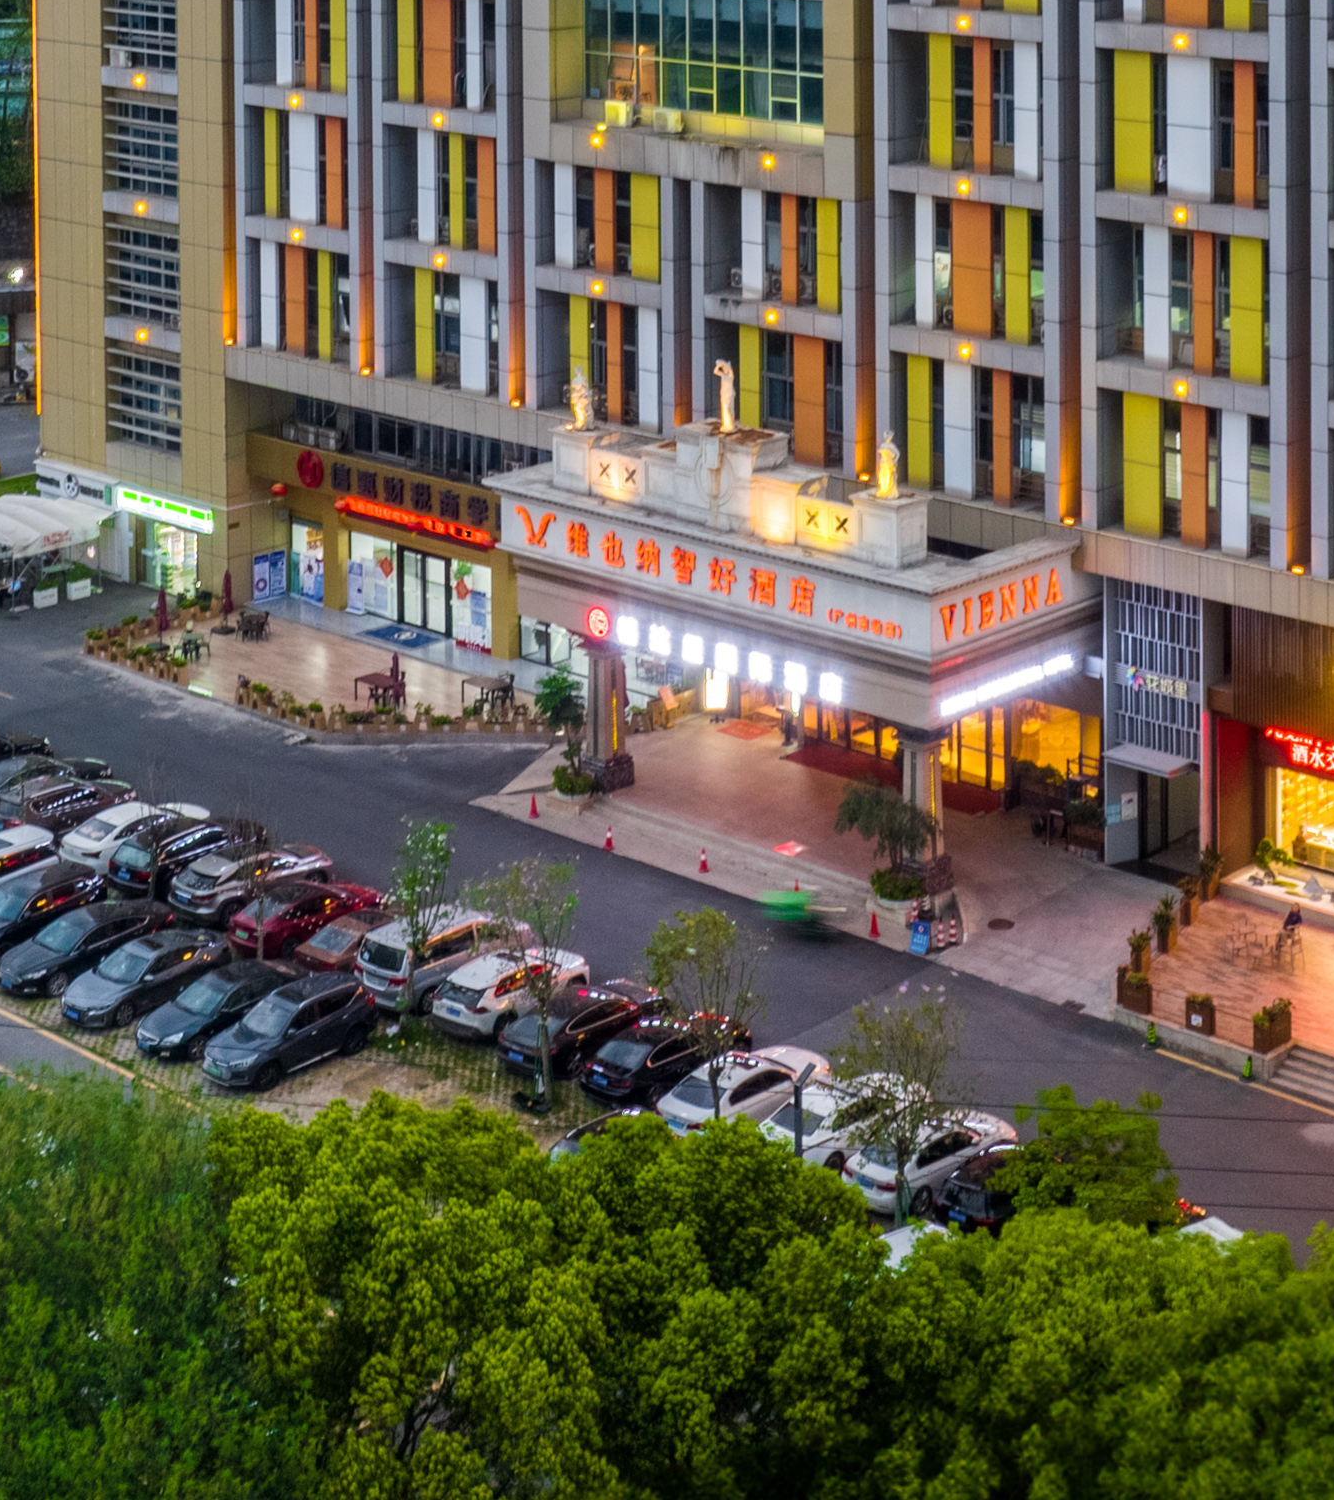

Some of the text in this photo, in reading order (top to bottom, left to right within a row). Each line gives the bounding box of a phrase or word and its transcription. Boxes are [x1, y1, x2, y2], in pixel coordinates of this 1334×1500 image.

[565, 520, 816, 617] 维也纳智好酒店
[940, 568, 1064, 642] VIENNA
